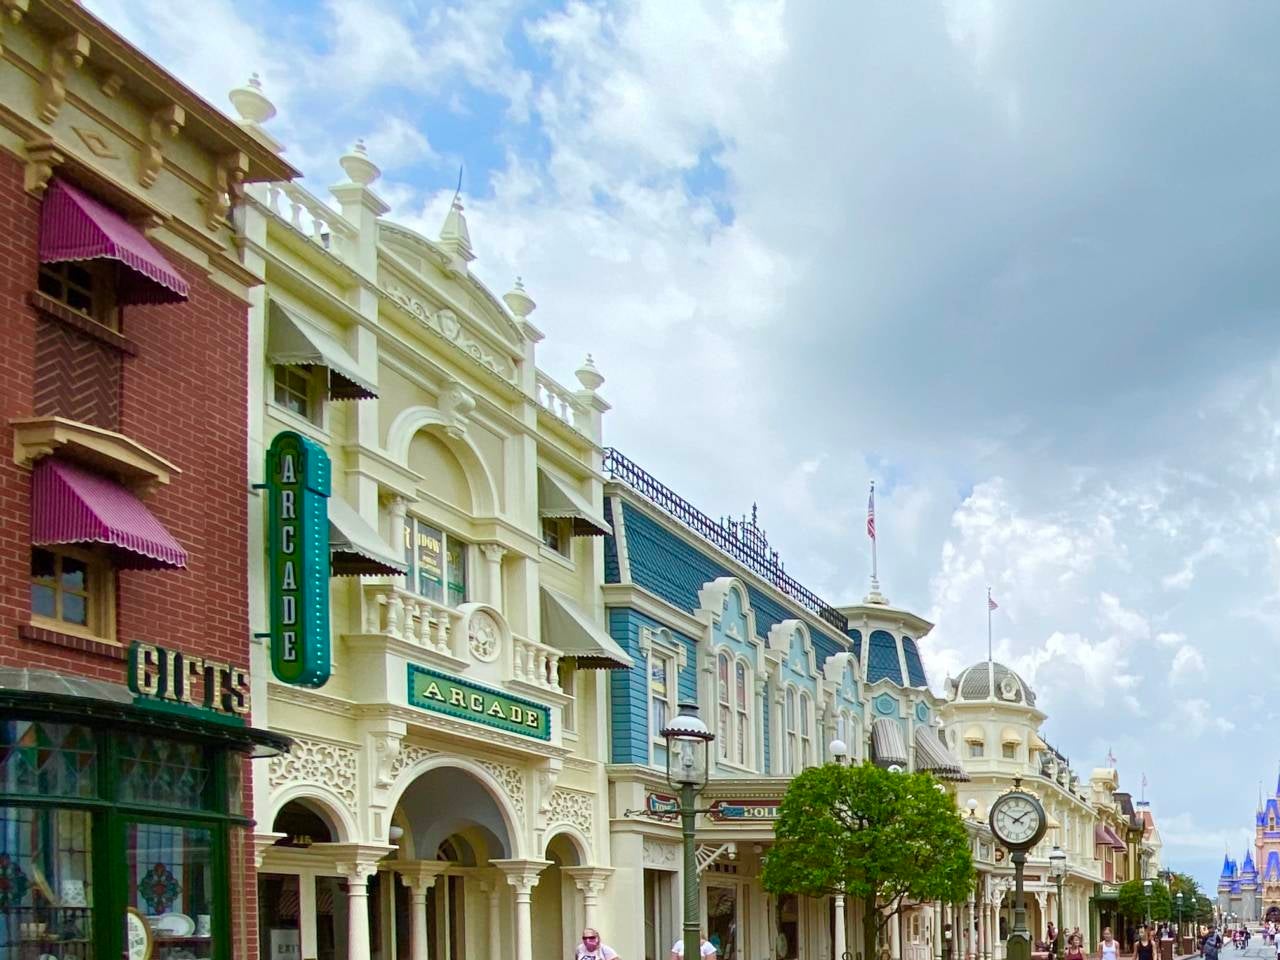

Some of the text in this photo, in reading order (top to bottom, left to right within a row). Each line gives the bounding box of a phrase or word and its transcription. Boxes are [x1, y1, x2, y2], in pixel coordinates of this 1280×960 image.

[281, 454, 297, 661] ARCADE
[135, 642, 250, 714] GIFTS
[423, 681, 539, 728] ARCADE
